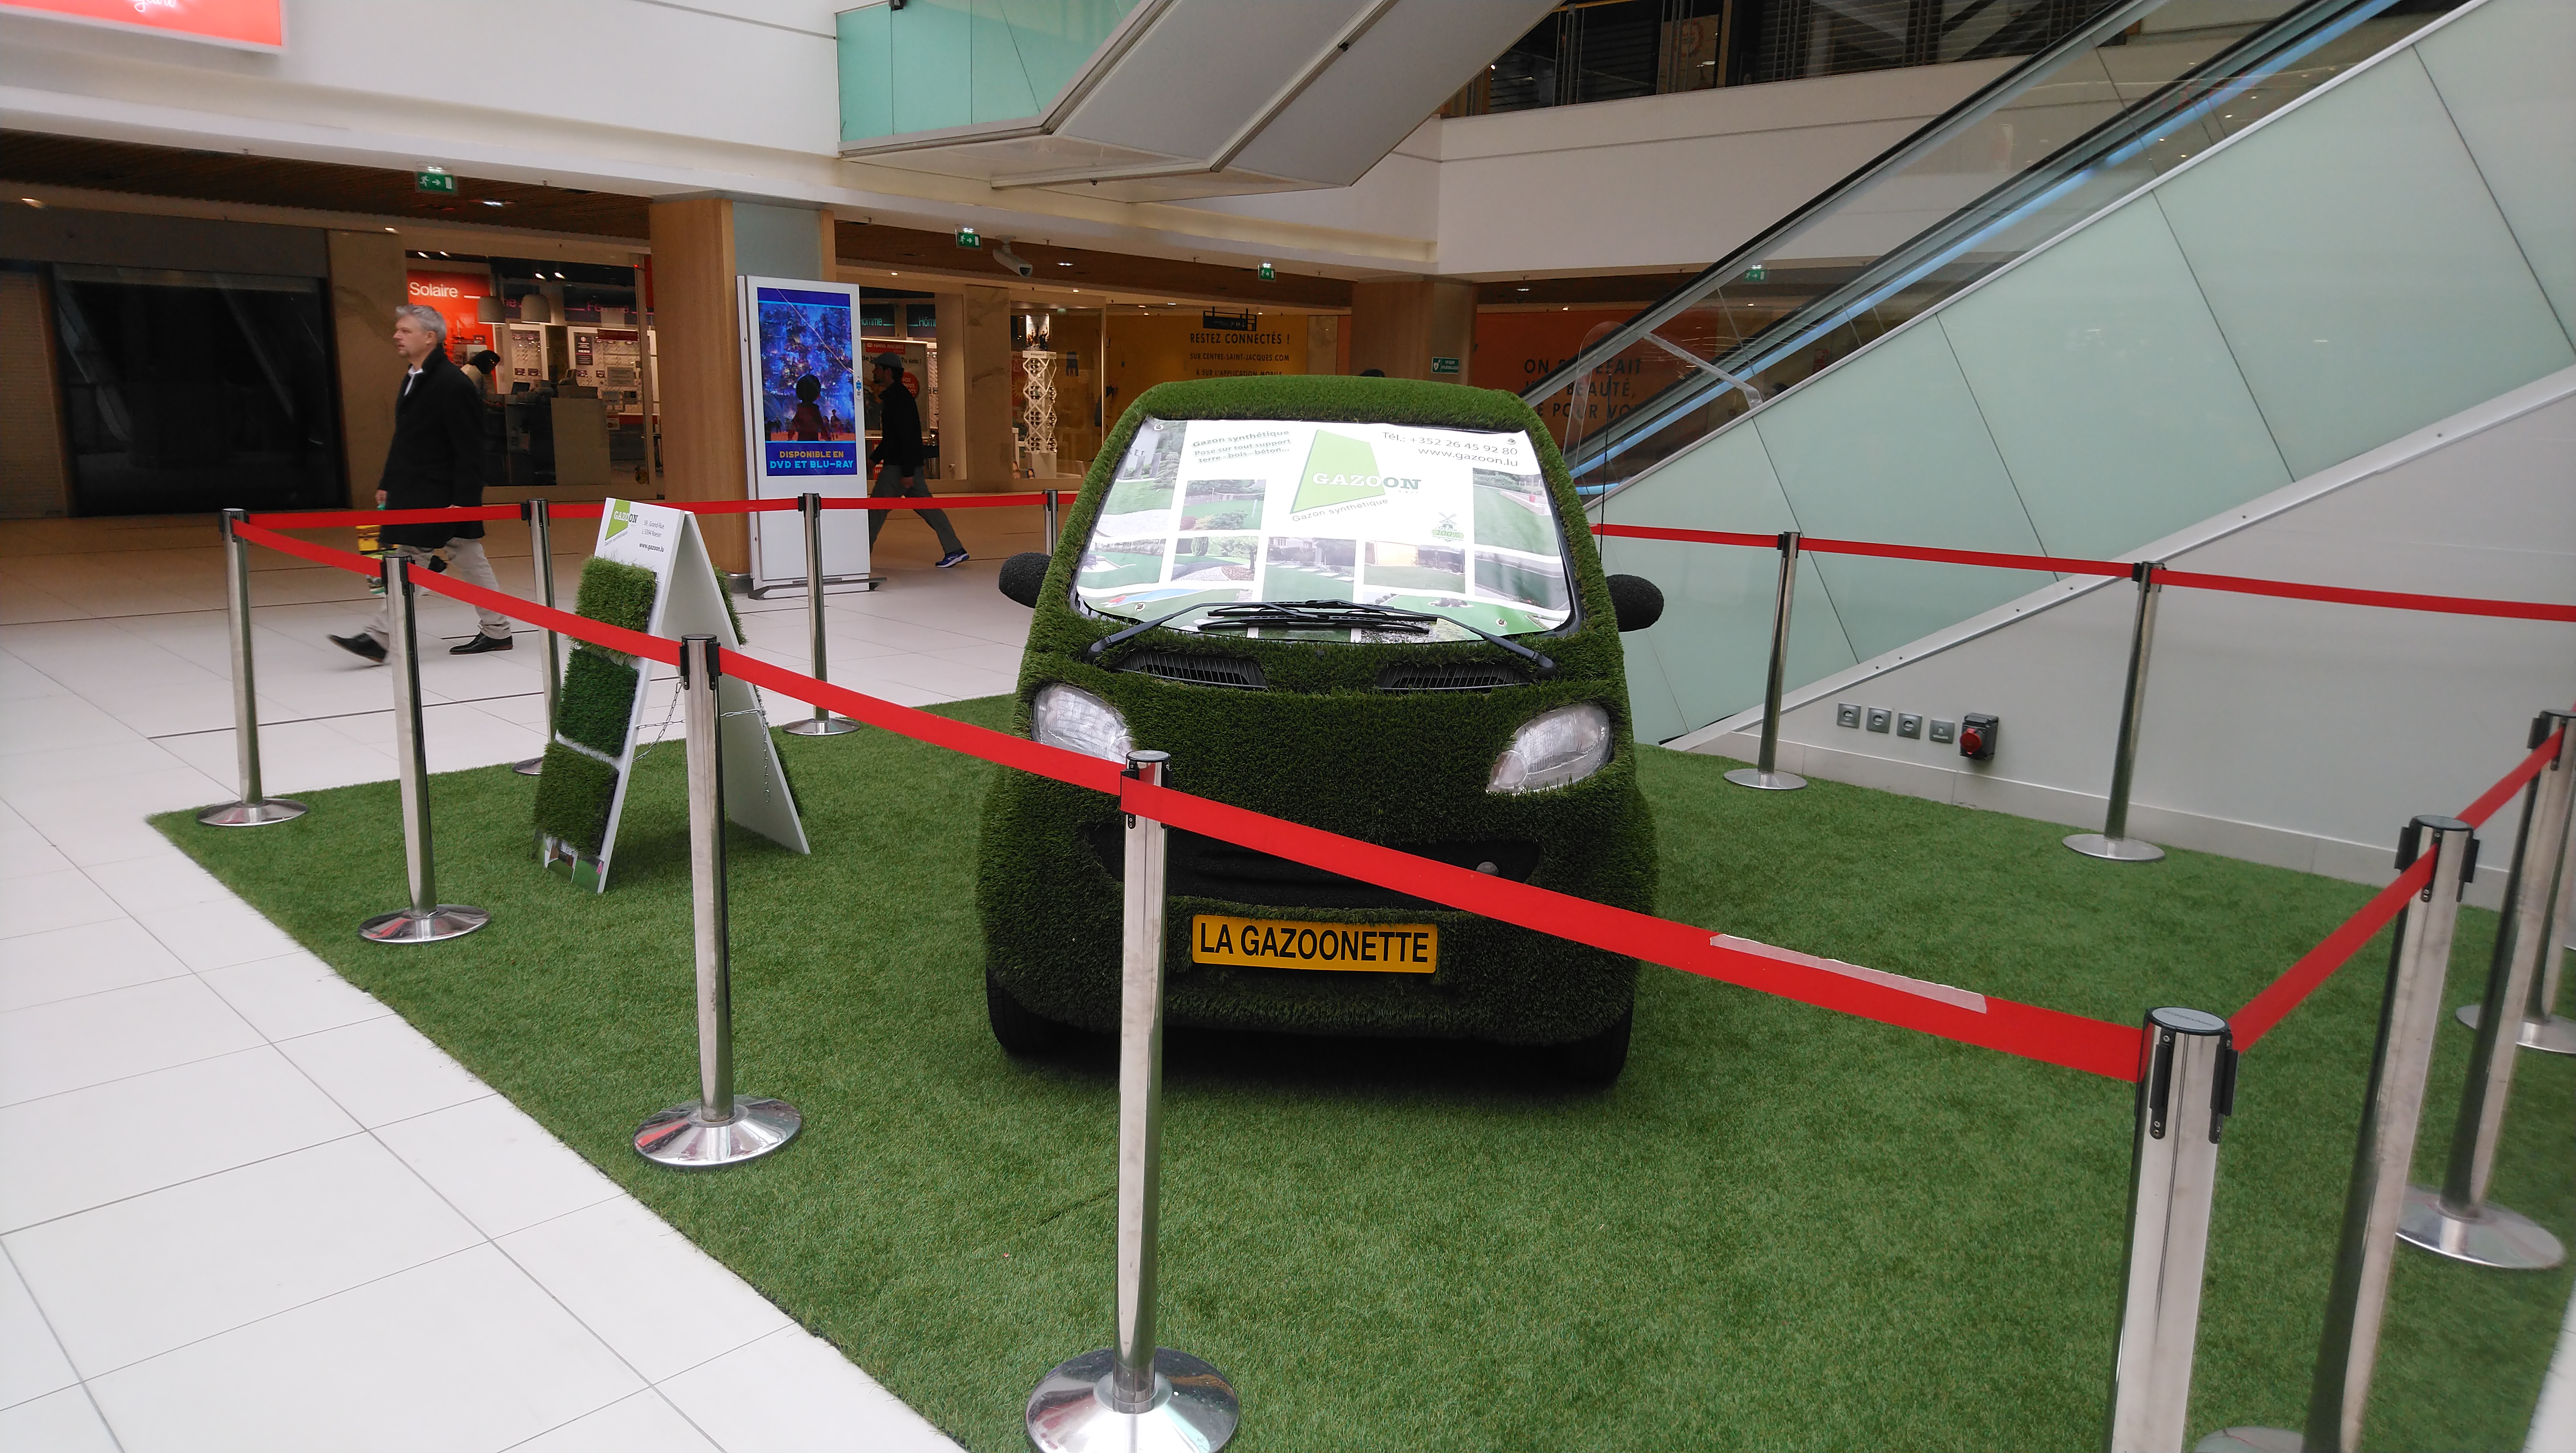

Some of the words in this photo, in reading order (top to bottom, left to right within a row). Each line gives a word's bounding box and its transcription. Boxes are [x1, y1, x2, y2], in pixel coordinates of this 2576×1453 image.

[410, 282, 458, 298] Solaire
[1190, 333, 1220, 343] RESTEZ
[1225, 332, 1282, 344] CONNECTÉS
[1287, 334, 1290, 344] !
[1203, 353, 1289, 362] CENTRE-SAINT-JACQUES.COM
[1524, 359, 1548, 374] ON
[1595, 359, 1641, 374] EFAIT
[1553, 403, 1598, 419] POUR
[1193, 437, 1225, 447] Gazon
[1228, 430, 1289, 442] synthétique
[1255, 439, 1291, 448] support
[1382, 432, 1405, 442] Tél.:
[1410, 437, 1441, 445] +352
[1483, 445, 1498, 453] 92
[770, 461, 791, 469] DVD
[795, 461, 807, 469] ET
[810, 460, 854, 469] BLU-RAY
[1418, 448, 1518, 467] www.gazoon.lu
[1312, 473, 1421, 490] GAZOON
[613, 510, 638, 523] GAZOON
[1292, 510, 1325, 521] Gazon
[1328, 498, 1388, 515] synthétique
[1437, 530, 1460, 538] 100%
[639, 543, 664, 552] www.gazoon.lu
[1201, 922, 1234, 954] LA
[1241, 925, 1429, 963] GAZOONETTE
